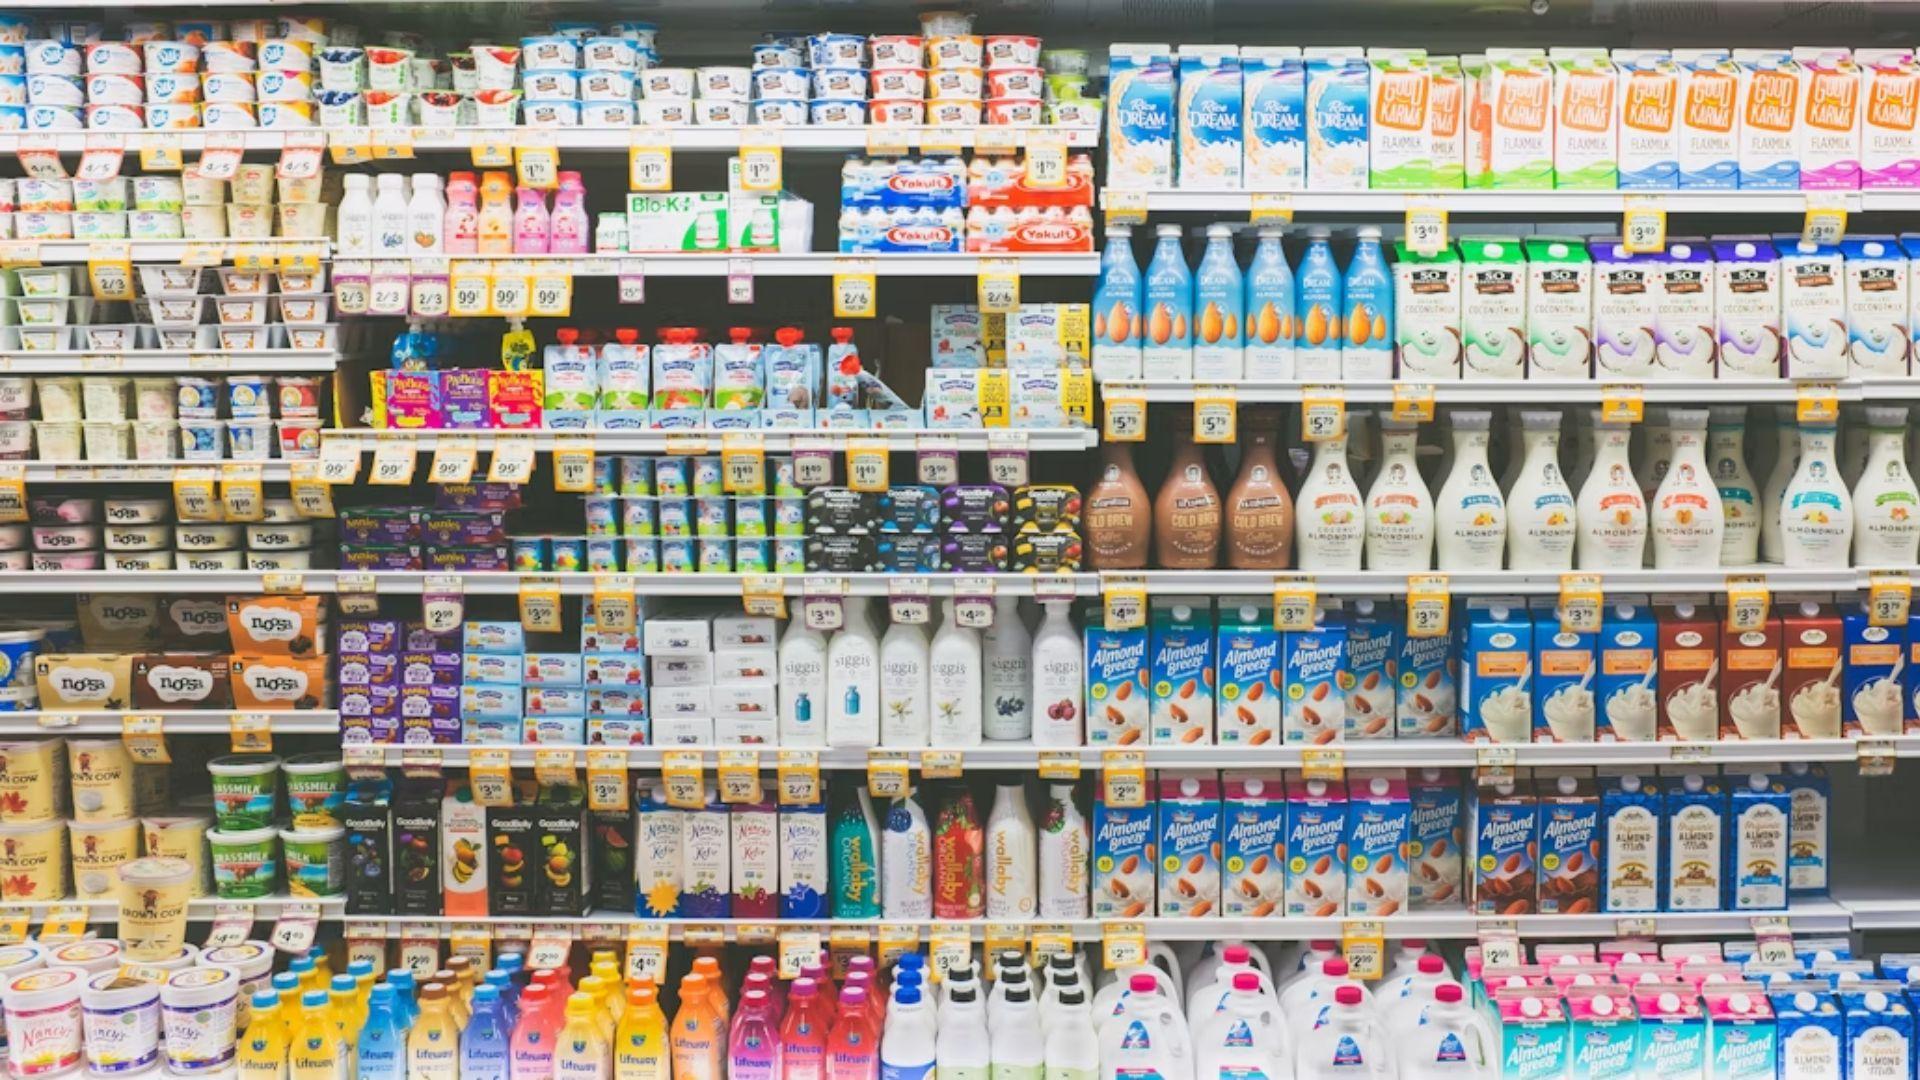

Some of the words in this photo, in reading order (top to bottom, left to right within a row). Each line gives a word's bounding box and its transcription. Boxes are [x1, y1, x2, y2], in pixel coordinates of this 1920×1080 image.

[1384, 79, 1423, 107] GOOD
[1506, 77, 1545, 107] GOOD
[1572, 77, 1608, 107] GOOD
[1634, 76, 1670, 106] GOOD
[1693, 76, 1731, 107] GOOD
[1755, 76, 1793, 107] GOOD
[1815, 75, 1851, 106] GOOD
[1877, 75, 1914, 106] GOOD
[1120, 112, 1166, 127] DREAM
[1190, 112, 1238, 128] DREAM
[1253, 112, 1301, 128] DREAM
[1316, 113, 1365, 128] DREAM
[1380, 104, 1423, 127] KARMA
[1502, 105, 1545, 128] KARMA
[1567, 105, 1608, 128] KARMA
[1630, 105, 1669, 128] KARMA
[1690, 105, 1730, 128] KARMA
[1751, 105, 1791, 128] KARMA
[1810, 105, 1850, 128] KARMA
[1873, 104, 1912, 127] KARMA
[1382, 136, 1422, 149] FLAXMILK
[1504, 137, 1542, 149] FLAXMILK
[1568, 137, 1607, 149] FLAXMILK
[1631, 137, 1670, 149] FLAXMILK
[1691, 137, 1730, 149] FLAXMILK
[1752, 137, 1791, 149] FLAXMILK
[1811, 137, 1850, 149] FLAXMILK
[1874, 136, 1912, 148] FLAXMILK
[899, 177, 943, 188] Yakult
[899, 231, 943, 241] Yakult
[1026, 228, 1073, 242] Yakult
[101, 278, 126, 290] 2/3
[341, 291, 364, 303] 2/3
[376, 291, 399, 302] 2/3
[420, 293, 442, 305] 2/3
[109, 507, 140, 519] noosa
[1172, 514, 1196, 527] COLD
[1235, 514, 1256, 528] COLD
[1259, 513, 1283, 527] BREW
[42, 534, 76, 546] noosa
[113, 533, 147, 545] noosa
[183, 533, 216, 545] noosa
[256, 533, 289, 545] noosa
[116, 559, 149, 571] noosa
[190, 559, 223, 571] noosa
[102, 605, 148, 621] noosa
[182, 608, 225, 624] noosa
[251, 616, 293, 632] noosa
[1092, 640, 1144, 669] Almond
[1156, 640, 1209, 668] Almond
[1224, 640, 1277, 669] Almond
[1288, 640, 1343, 669] Almond
[1103, 656, 1139, 678] Breeze
[1167, 656, 1204, 676] Breeze
[1234, 657, 1271, 679] Breeze
[1301, 656, 1337, 678] Breeze
[61, 677, 106, 692] noosa
[160, 676, 204, 692] noosa
[256, 676, 299, 692] noosa
[96, 770, 121, 782] COW
[346, 818, 387, 829] GoodBelly
[397, 817, 437, 828] GoodBelly
[492, 819, 533, 829] GoodBelly
[539, 819, 580, 830] GoodBelly
[1098, 815, 1151, 842] Almond
[1164, 814, 1218, 842] Almond
[1227, 818, 1281, 843] Almond
[1290, 817, 1344, 842] Almond
[1352, 813, 1407, 841] Almond
[1481, 814, 1534, 841] Almond
[1543, 812, 1596, 840] Almond
[1109, 831, 1146, 852] Breeze
[1176, 831, 1212, 852] Breeze
[1239, 832, 1276, 853] Breeze
[1302, 832, 1338, 853] Breeze
[1364, 830, 1400, 851] Breeze
[1492, 830, 1529, 851] Breeze
[1556, 830, 1591, 851] Breeze
[848, 836, 868, 902] wallaby
[912, 831, 931, 896] wallaby
[942, 836, 963, 902] wallaby
[997, 831, 1013, 896] wallaby
[1065, 831, 1086, 894] wallaby
[675, 1037, 710, 1049] Lifeway
[1507, 1038, 1563, 1066] Almond
[1577, 1036, 1634, 1064] Almond
[1643, 1034, 1700, 1062] Almond
[1716, 1034, 1773, 1062] Almond
[416, 1049, 452, 1060] Lifeway
[468, 1049, 505, 1060] Lifeway
[515, 1050, 552, 1062] Lifeway
[620, 1053, 657, 1066] Lifeway
[735, 1056, 772, 1069] Lifeway
[834, 1053, 870, 1065] Lifeway
[1590, 1054, 1628, 1076] Breeze
[1656, 1052, 1694, 1074] Breeze
[1728, 1052, 1766, 1073] Breeze
[561, 1059, 597, 1073] Lifeway
[1519, 1054, 1557, 1077] Breeze
